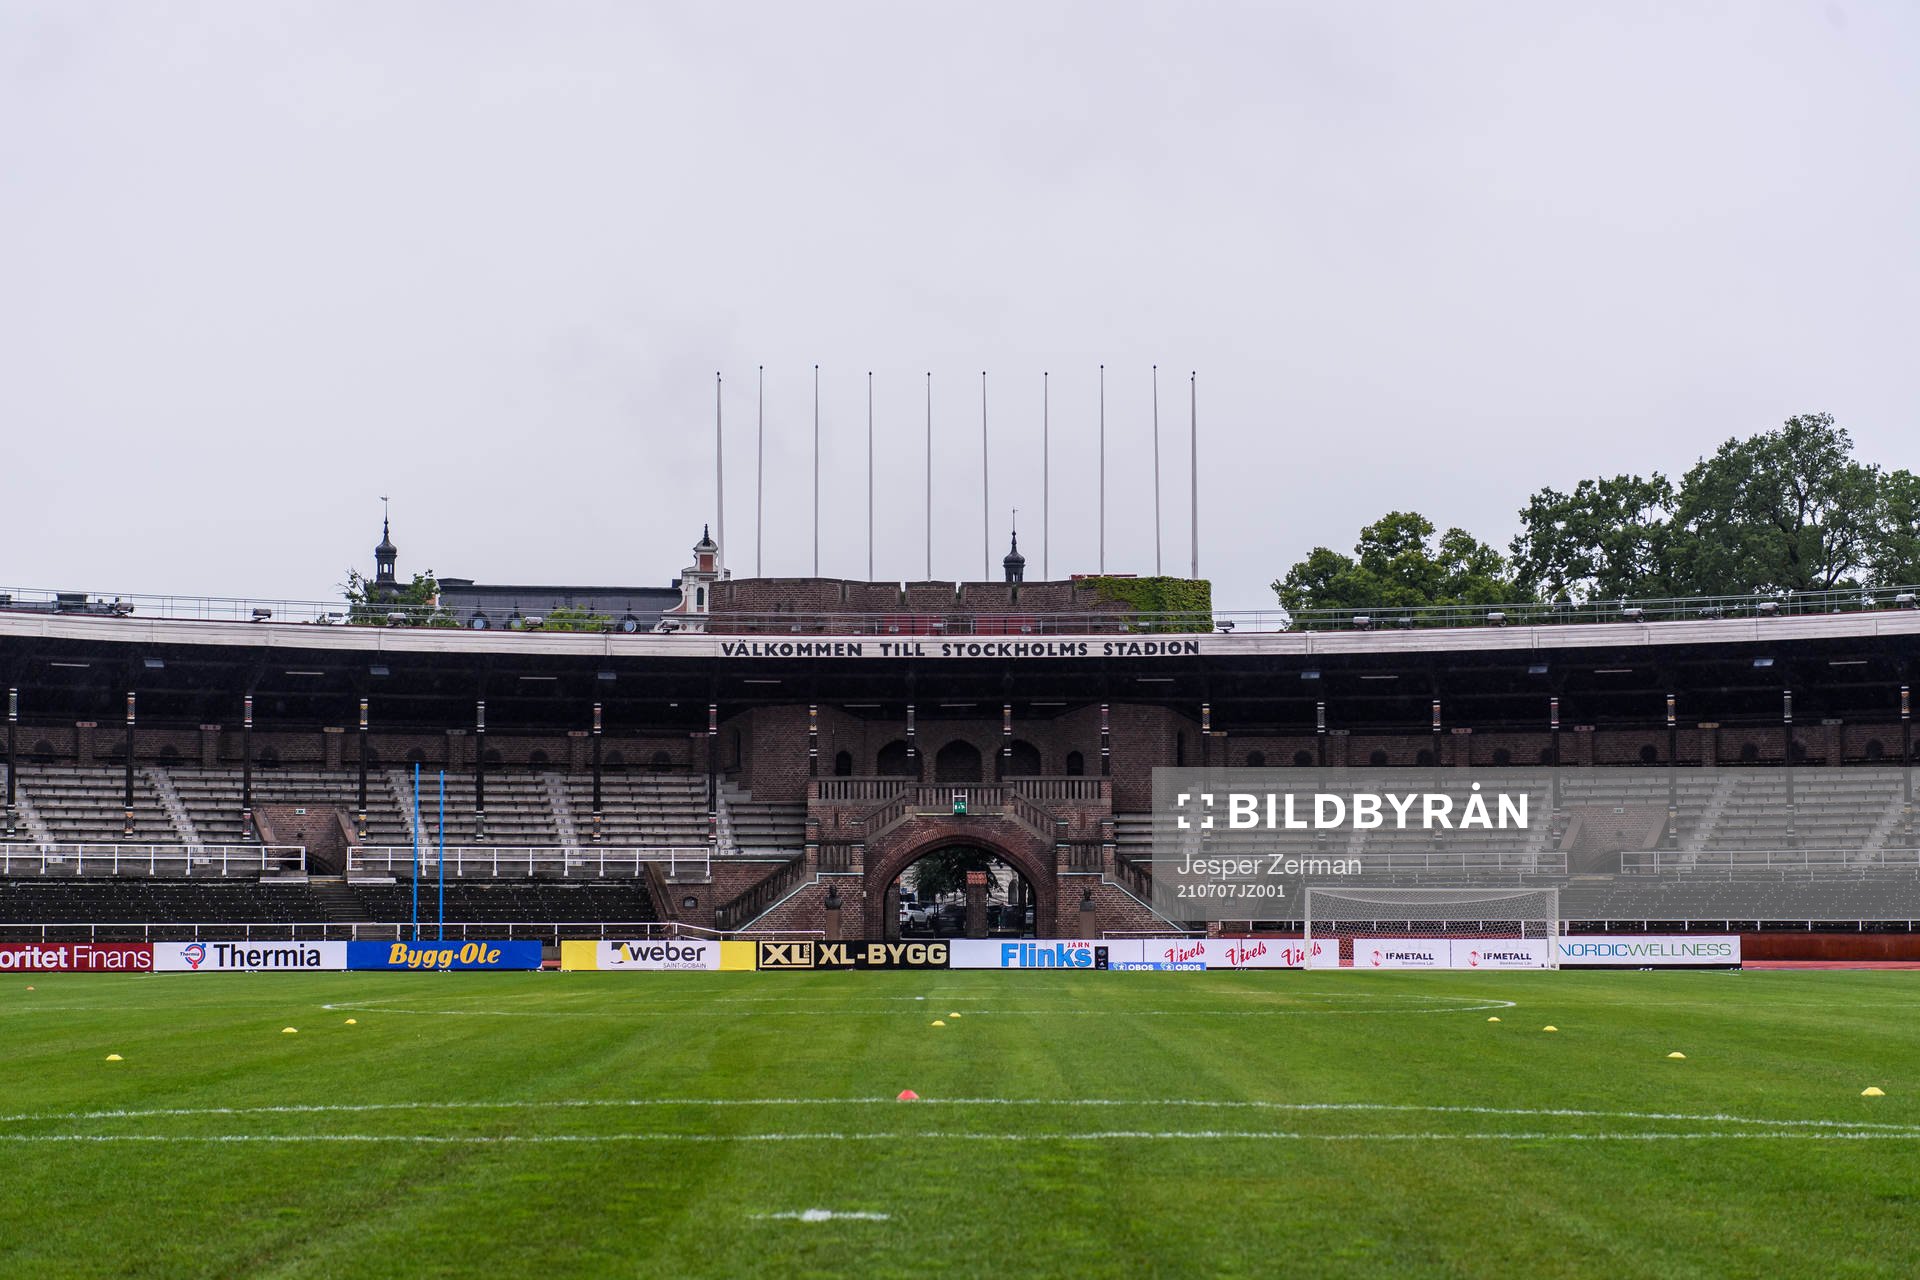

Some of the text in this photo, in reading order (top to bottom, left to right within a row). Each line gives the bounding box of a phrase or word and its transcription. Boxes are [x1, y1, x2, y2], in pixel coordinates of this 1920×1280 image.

[721, 640, 1199, 657] VÄLKOMMEN TILL STOCKHOLMS STADION
[73, 945, 150, 968] Finans
[213, 943, 321, 967] Thermia
[629, 942, 706, 962] weber
[763, 944, 810, 965] XL
[818, 943, 947, 965] XL-BYGG
[1001, 943, 1092, 968] Flinks
